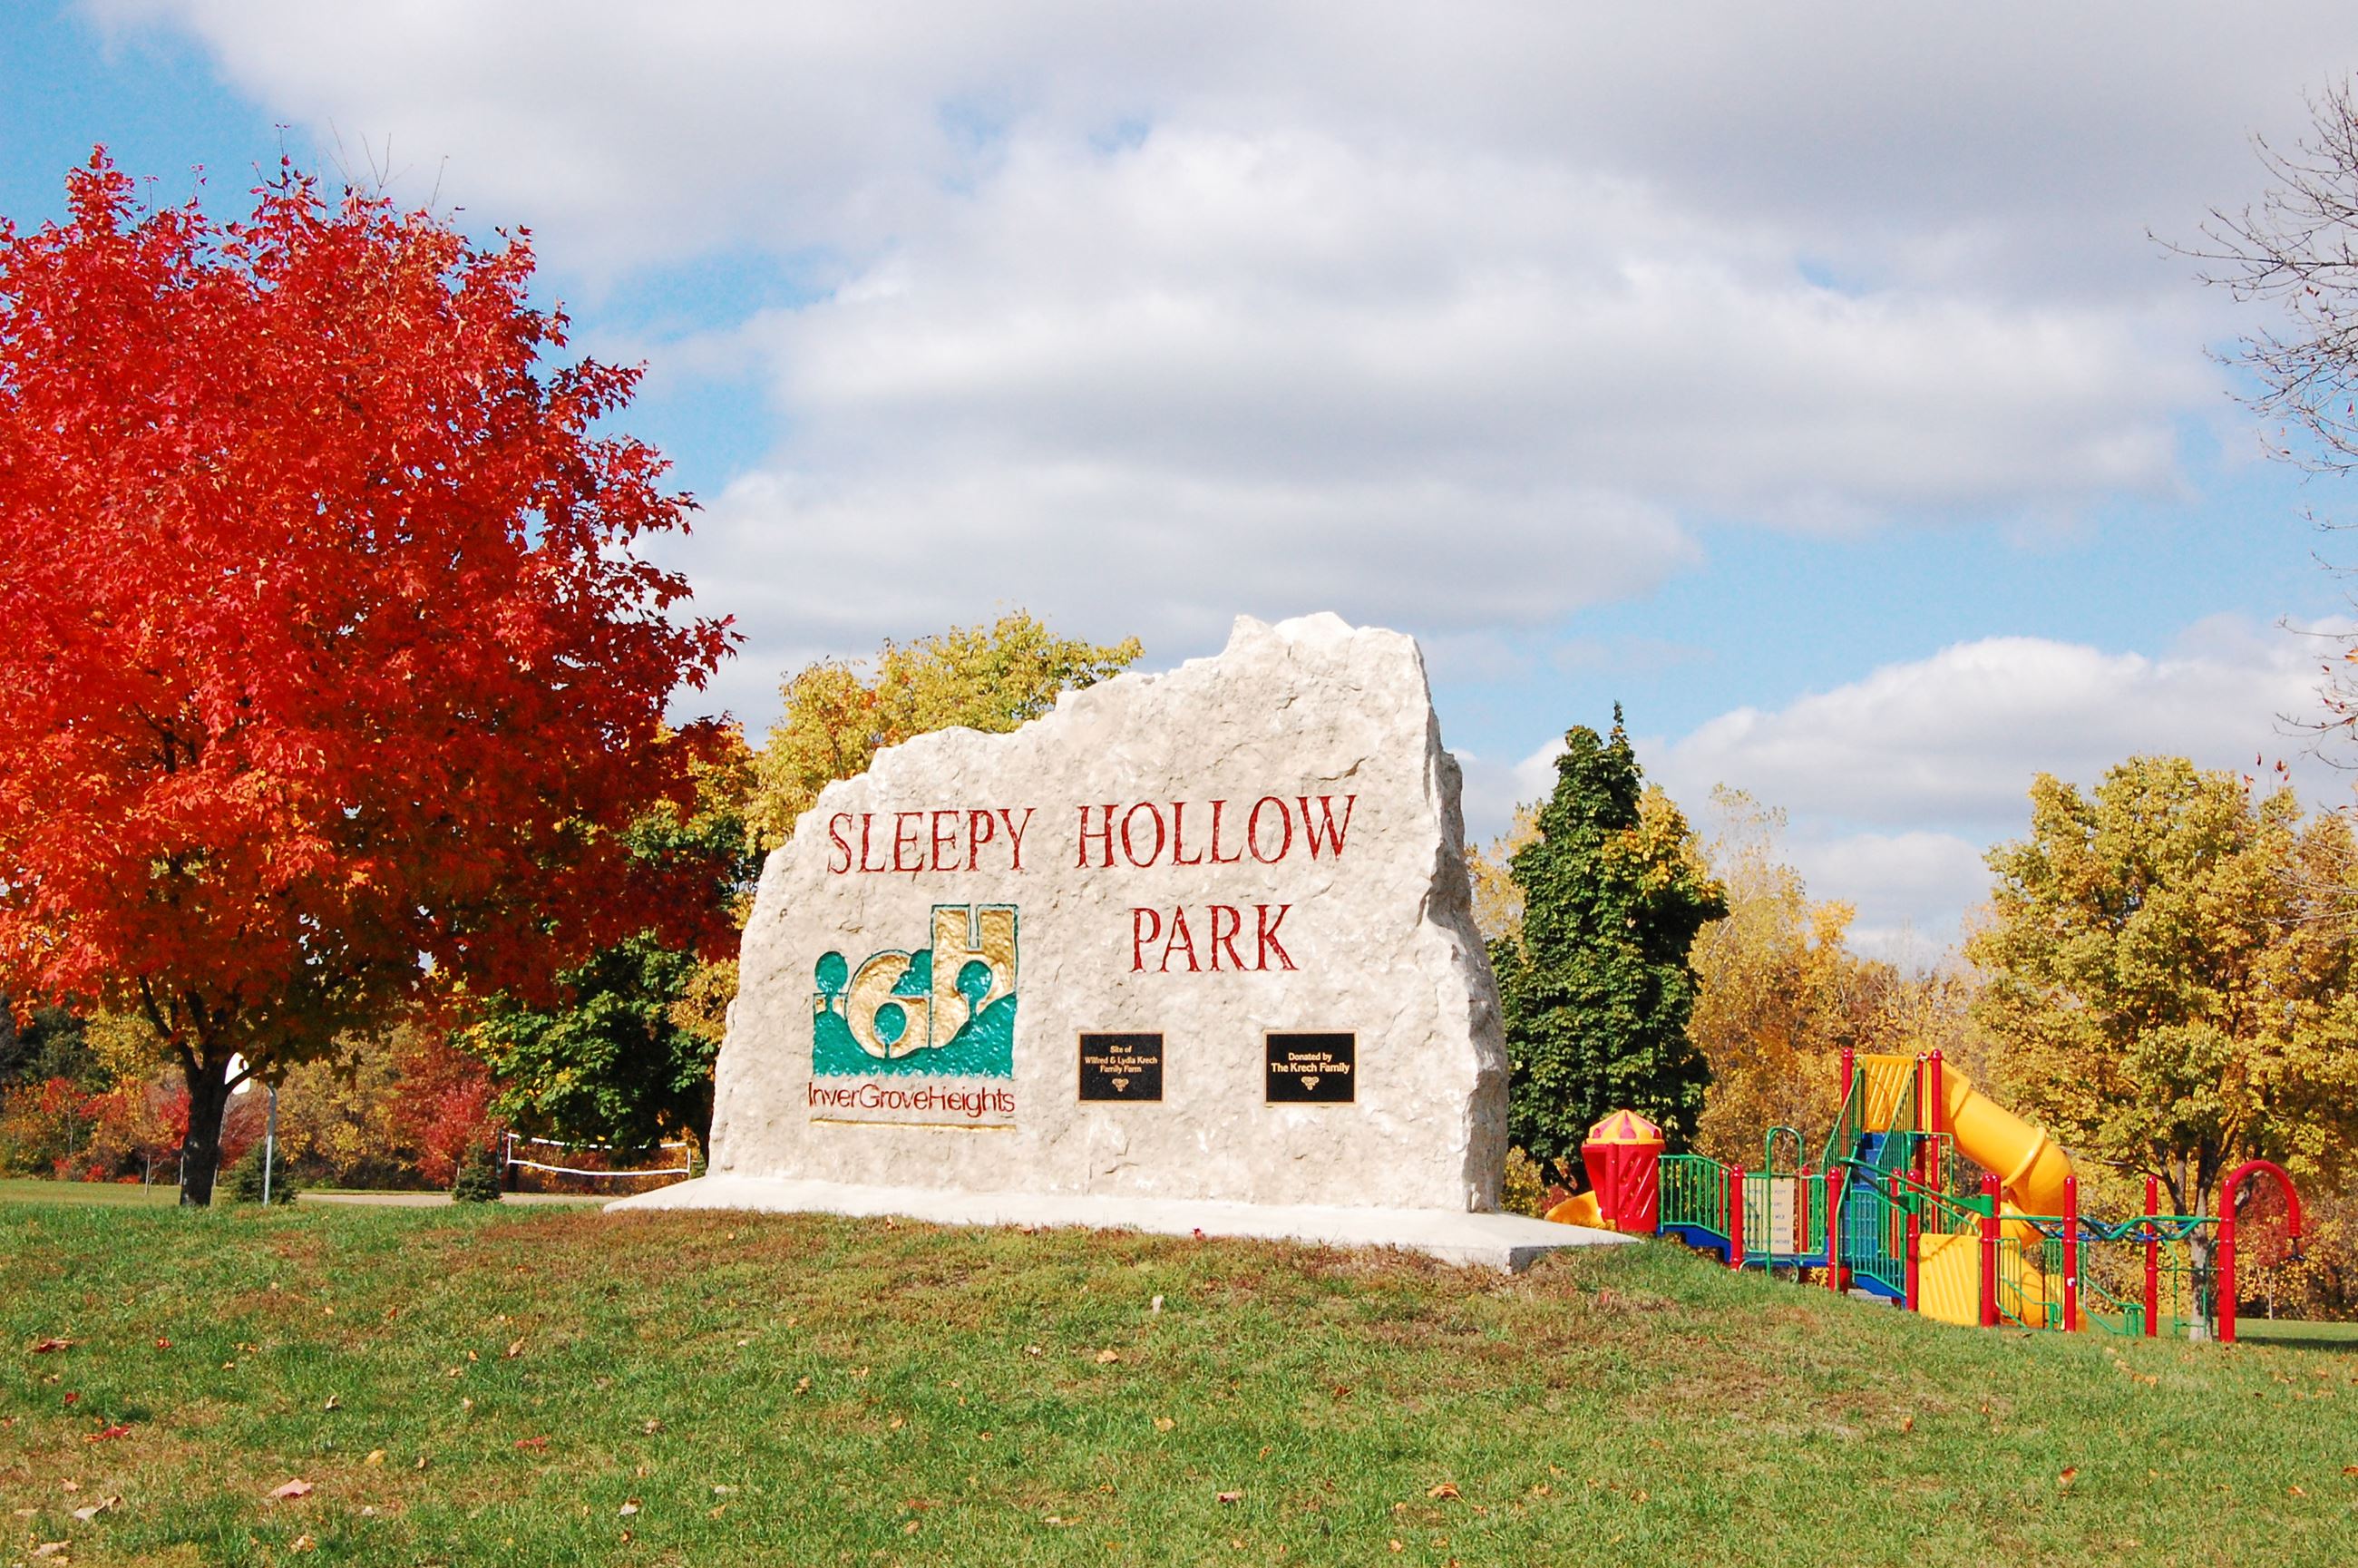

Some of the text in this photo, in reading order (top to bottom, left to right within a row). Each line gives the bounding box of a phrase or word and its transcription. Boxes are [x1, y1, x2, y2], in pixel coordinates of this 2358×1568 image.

[828, 794, 1357, 874] SLEEPY HOLLOW
[1130, 904, 1299, 973] PARK
[1109, 1045, 1133, 1054] Site of
[1085, 1056, 1158, 1066] Wilfred & Lydia Krech
[1288, 1052, 1332, 1063] Donated by
[1099, 1065, 1142, 1074] Family Farm
[1271, 1062, 1350, 1075] The Krech Family
